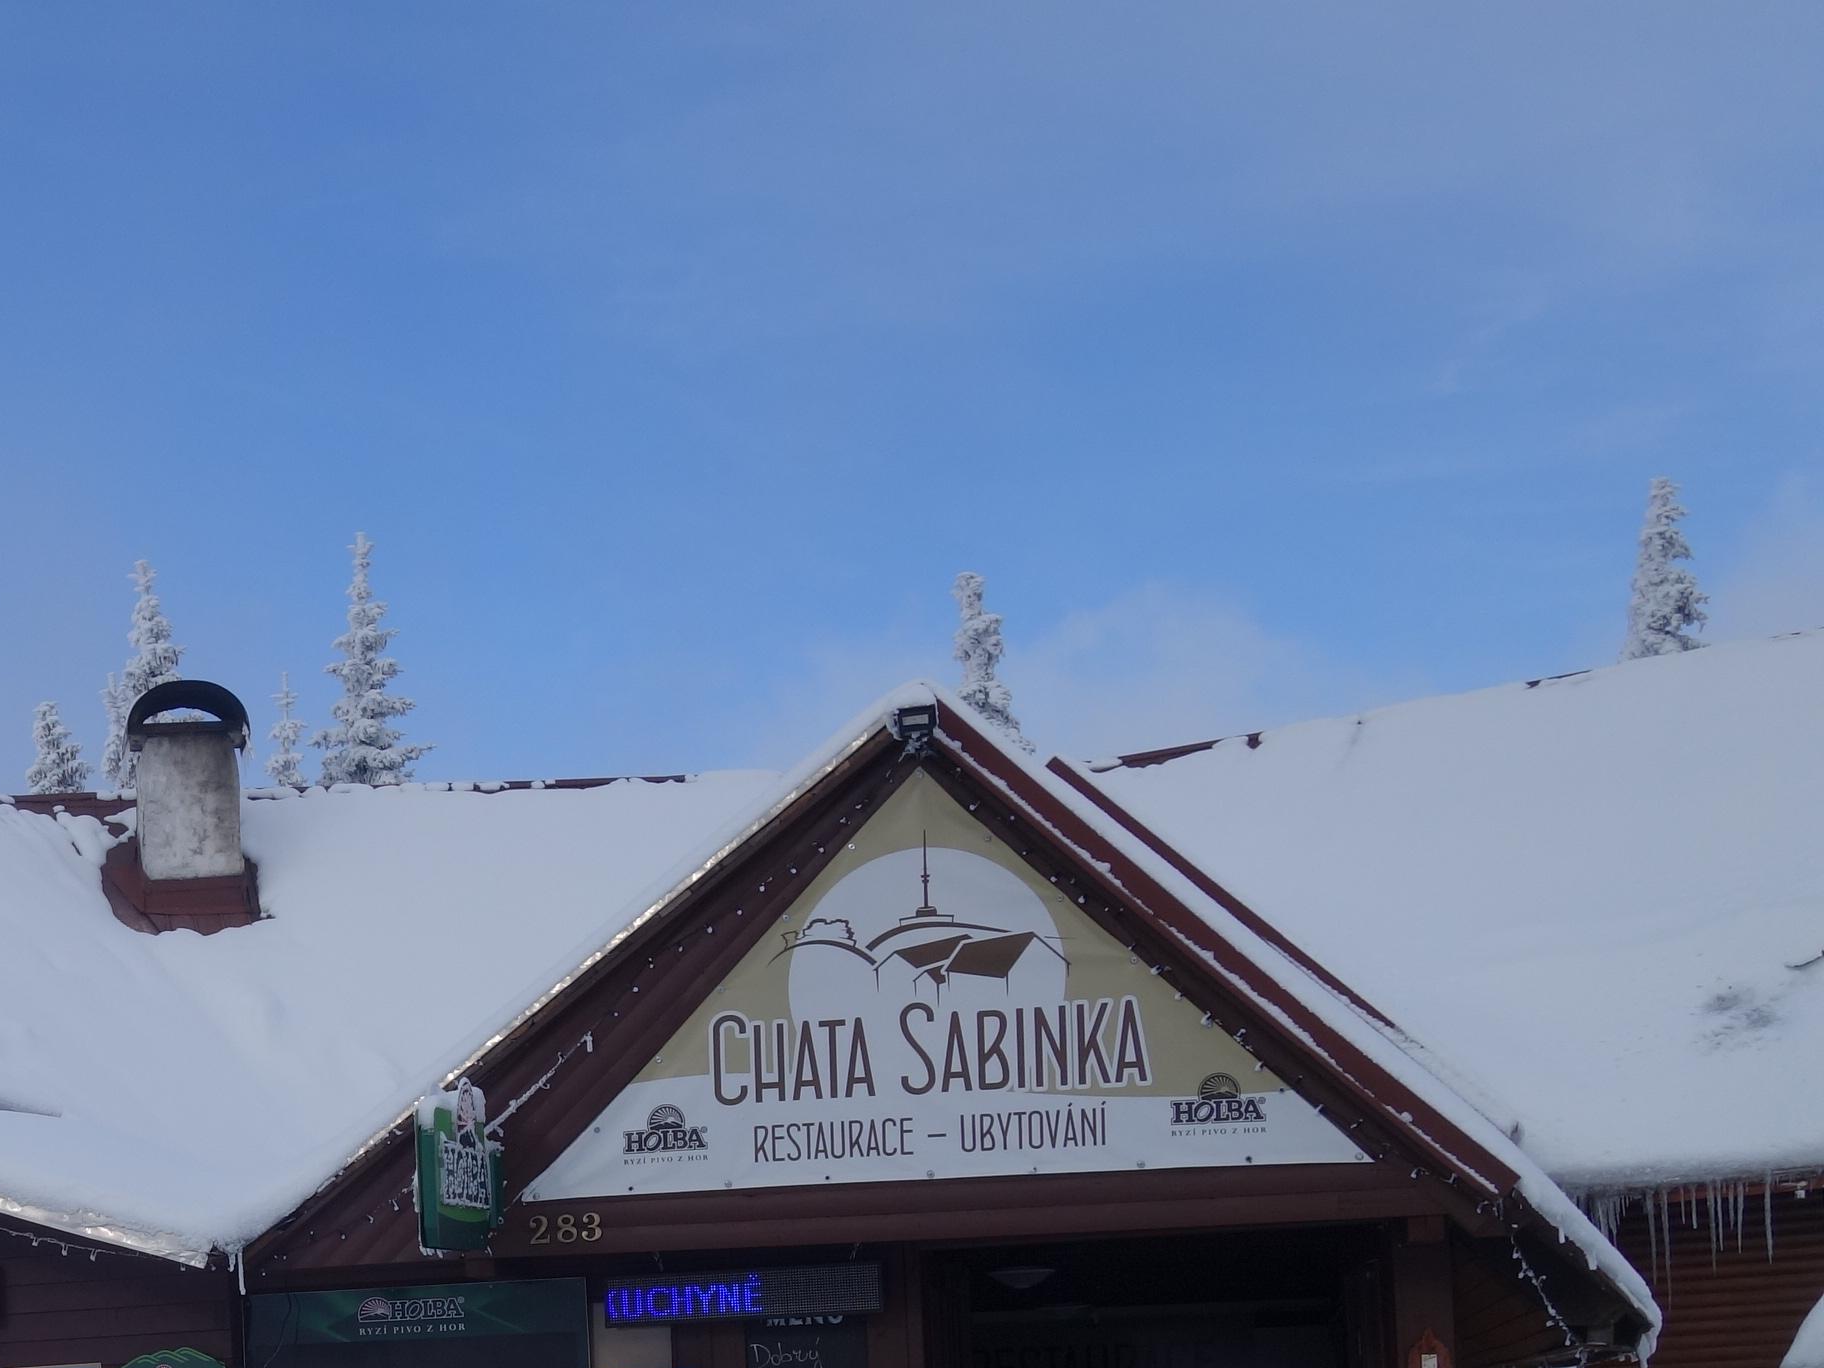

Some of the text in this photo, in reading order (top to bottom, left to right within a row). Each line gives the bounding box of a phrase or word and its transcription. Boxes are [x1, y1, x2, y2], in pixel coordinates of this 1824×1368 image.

[712, 1000, 1148, 1106] CHATA SABINKA
[753, 1117, 914, 1163] RESTAURACE
[959, 1101, 1107, 1153] UBYTOVÁNÍ
[1202, 1127, 1227, 1136] PIVO
[1243, 1126, 1267, 1134] HOR
[650, 1156, 673, 1164] PIVO
[688, 1154, 709, 1162] HOR
[528, 1212, 603, 1245] 283
[358, 1322, 467, 1336] RYZÍ PIVO Z HOR
